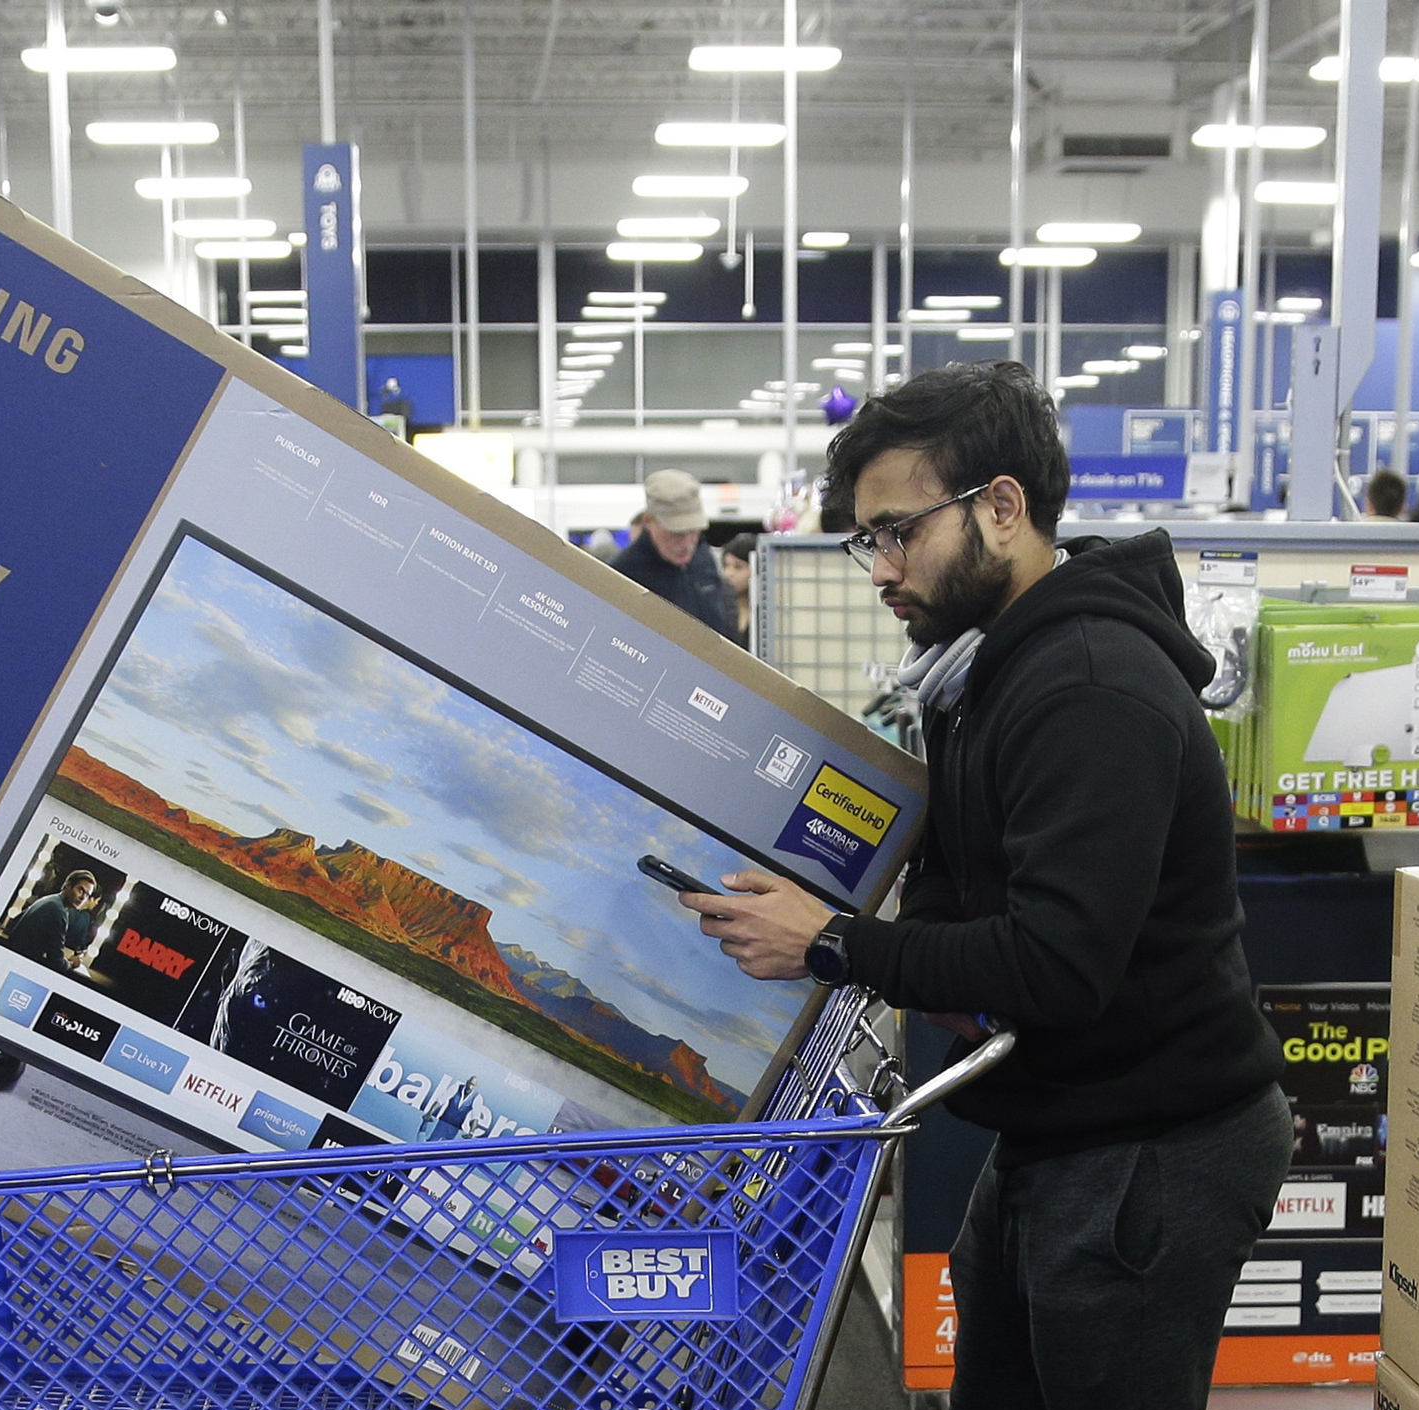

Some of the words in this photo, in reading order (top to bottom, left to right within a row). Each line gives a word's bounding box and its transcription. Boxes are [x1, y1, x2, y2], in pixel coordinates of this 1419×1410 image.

[318, 201, 338, 251] TOYS
[274, 434, 321, 467] PURCOLOR
[368, 491, 389, 508] HDR
[519, 594, 570, 628] RESOLUTION
[1333, 642, 1364, 657] Leaf
[1278, 771, 1326, 792] GET
[1333, 769, 1394, 790] FREE
[816, 782, 863, 817] Certified
[861, 808, 886, 831] UHD
[49, 816, 95, 846] Popular
[93, 837, 121, 859] Now
[116, 928, 195, 980] BARRY
[1330, 1001, 1360, 1011] Videos
[288, 1012, 344, 1053] GAME
[1308, 1021, 1349, 1040] The
[270, 1024, 351, 1080] THRONES
[1282, 1036, 1362, 1063] Good
[184, 1073, 244, 1113] NETFLIX
[1349, 1083, 1378, 1094] NBC
[1316, 1122, 1374, 1142] Empire
[1355, 1155, 1374, 1165] FOX
[1275, 1197, 1335, 1214] NETFLIX
[602, 1248, 708, 1274] BEST
[607, 1273, 706, 1300] BUY
[1389, 1260, 1419, 1301] Klipsch
[1308, 1351, 1333, 1363] dts
